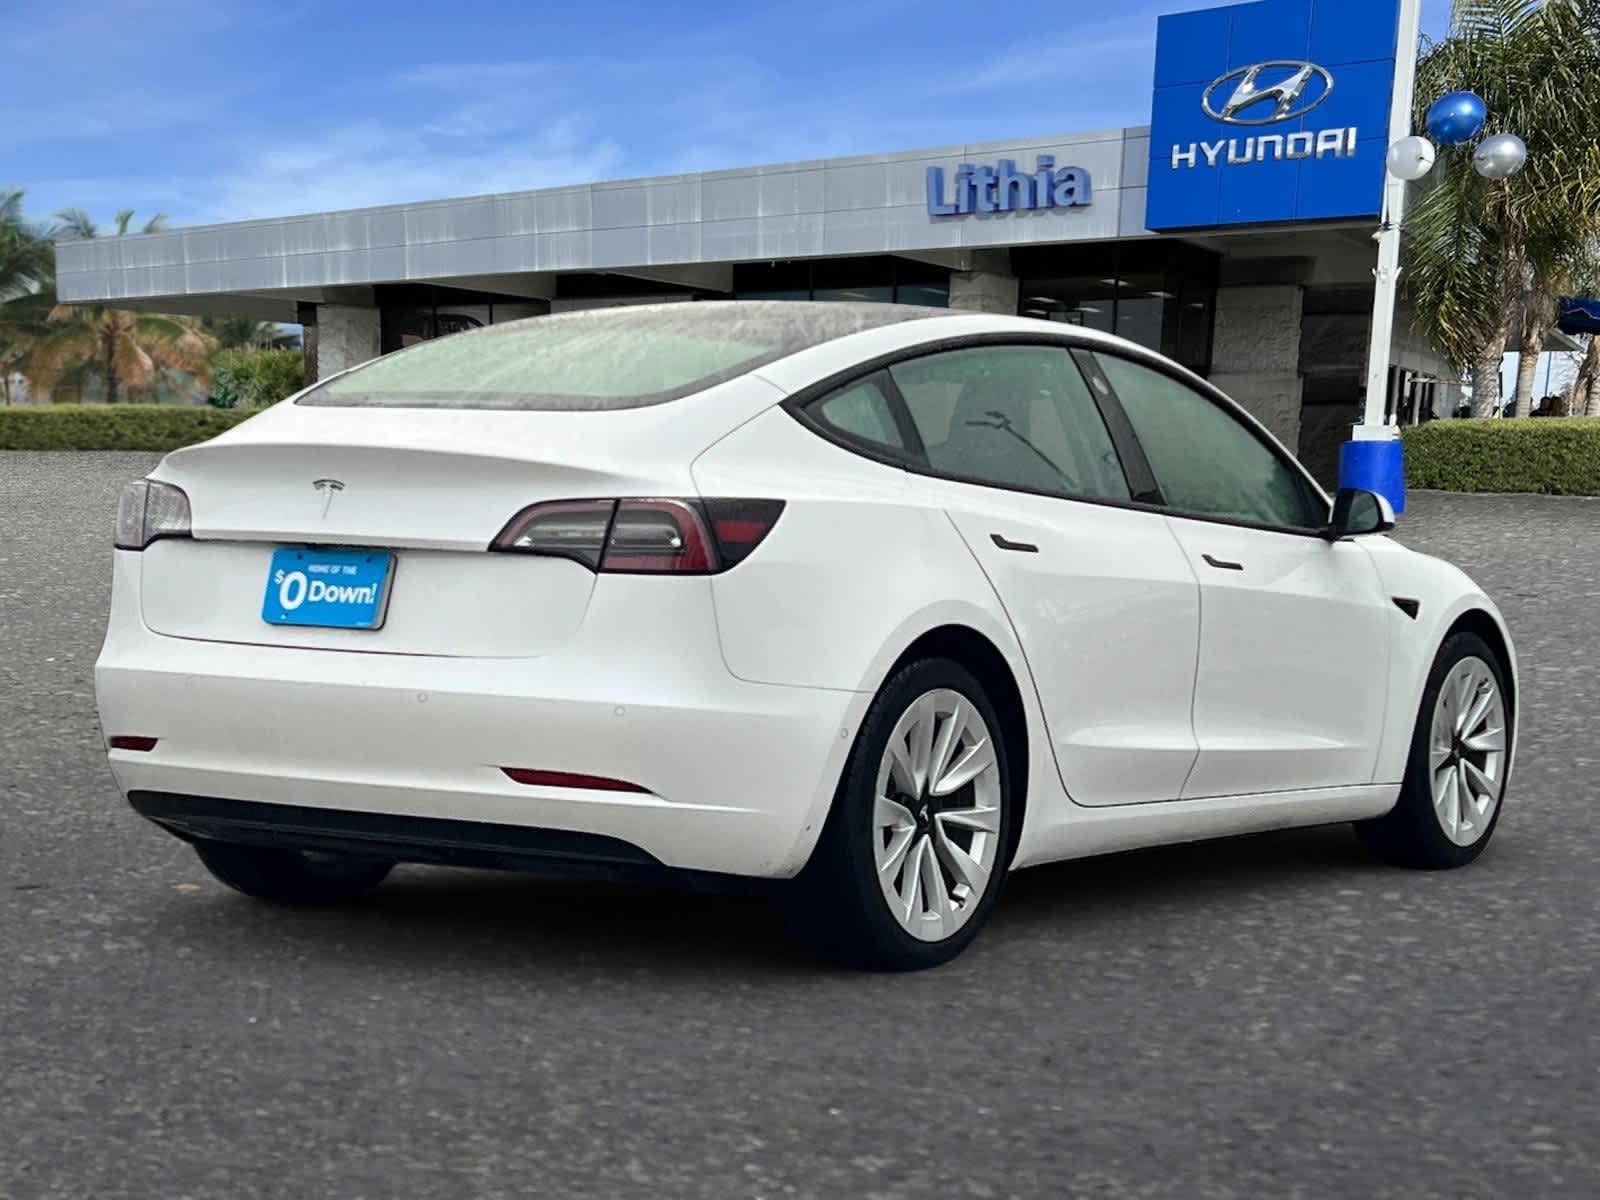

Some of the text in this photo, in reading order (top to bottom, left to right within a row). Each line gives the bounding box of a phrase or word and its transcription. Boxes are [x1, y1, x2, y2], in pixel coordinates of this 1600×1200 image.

[1171, 127, 1357, 169] HYUNDAI
[927, 154, 1092, 217] Lithia
[308, 564, 357, 575] HOME OF THE
[308, 580, 377, 604] Down!
